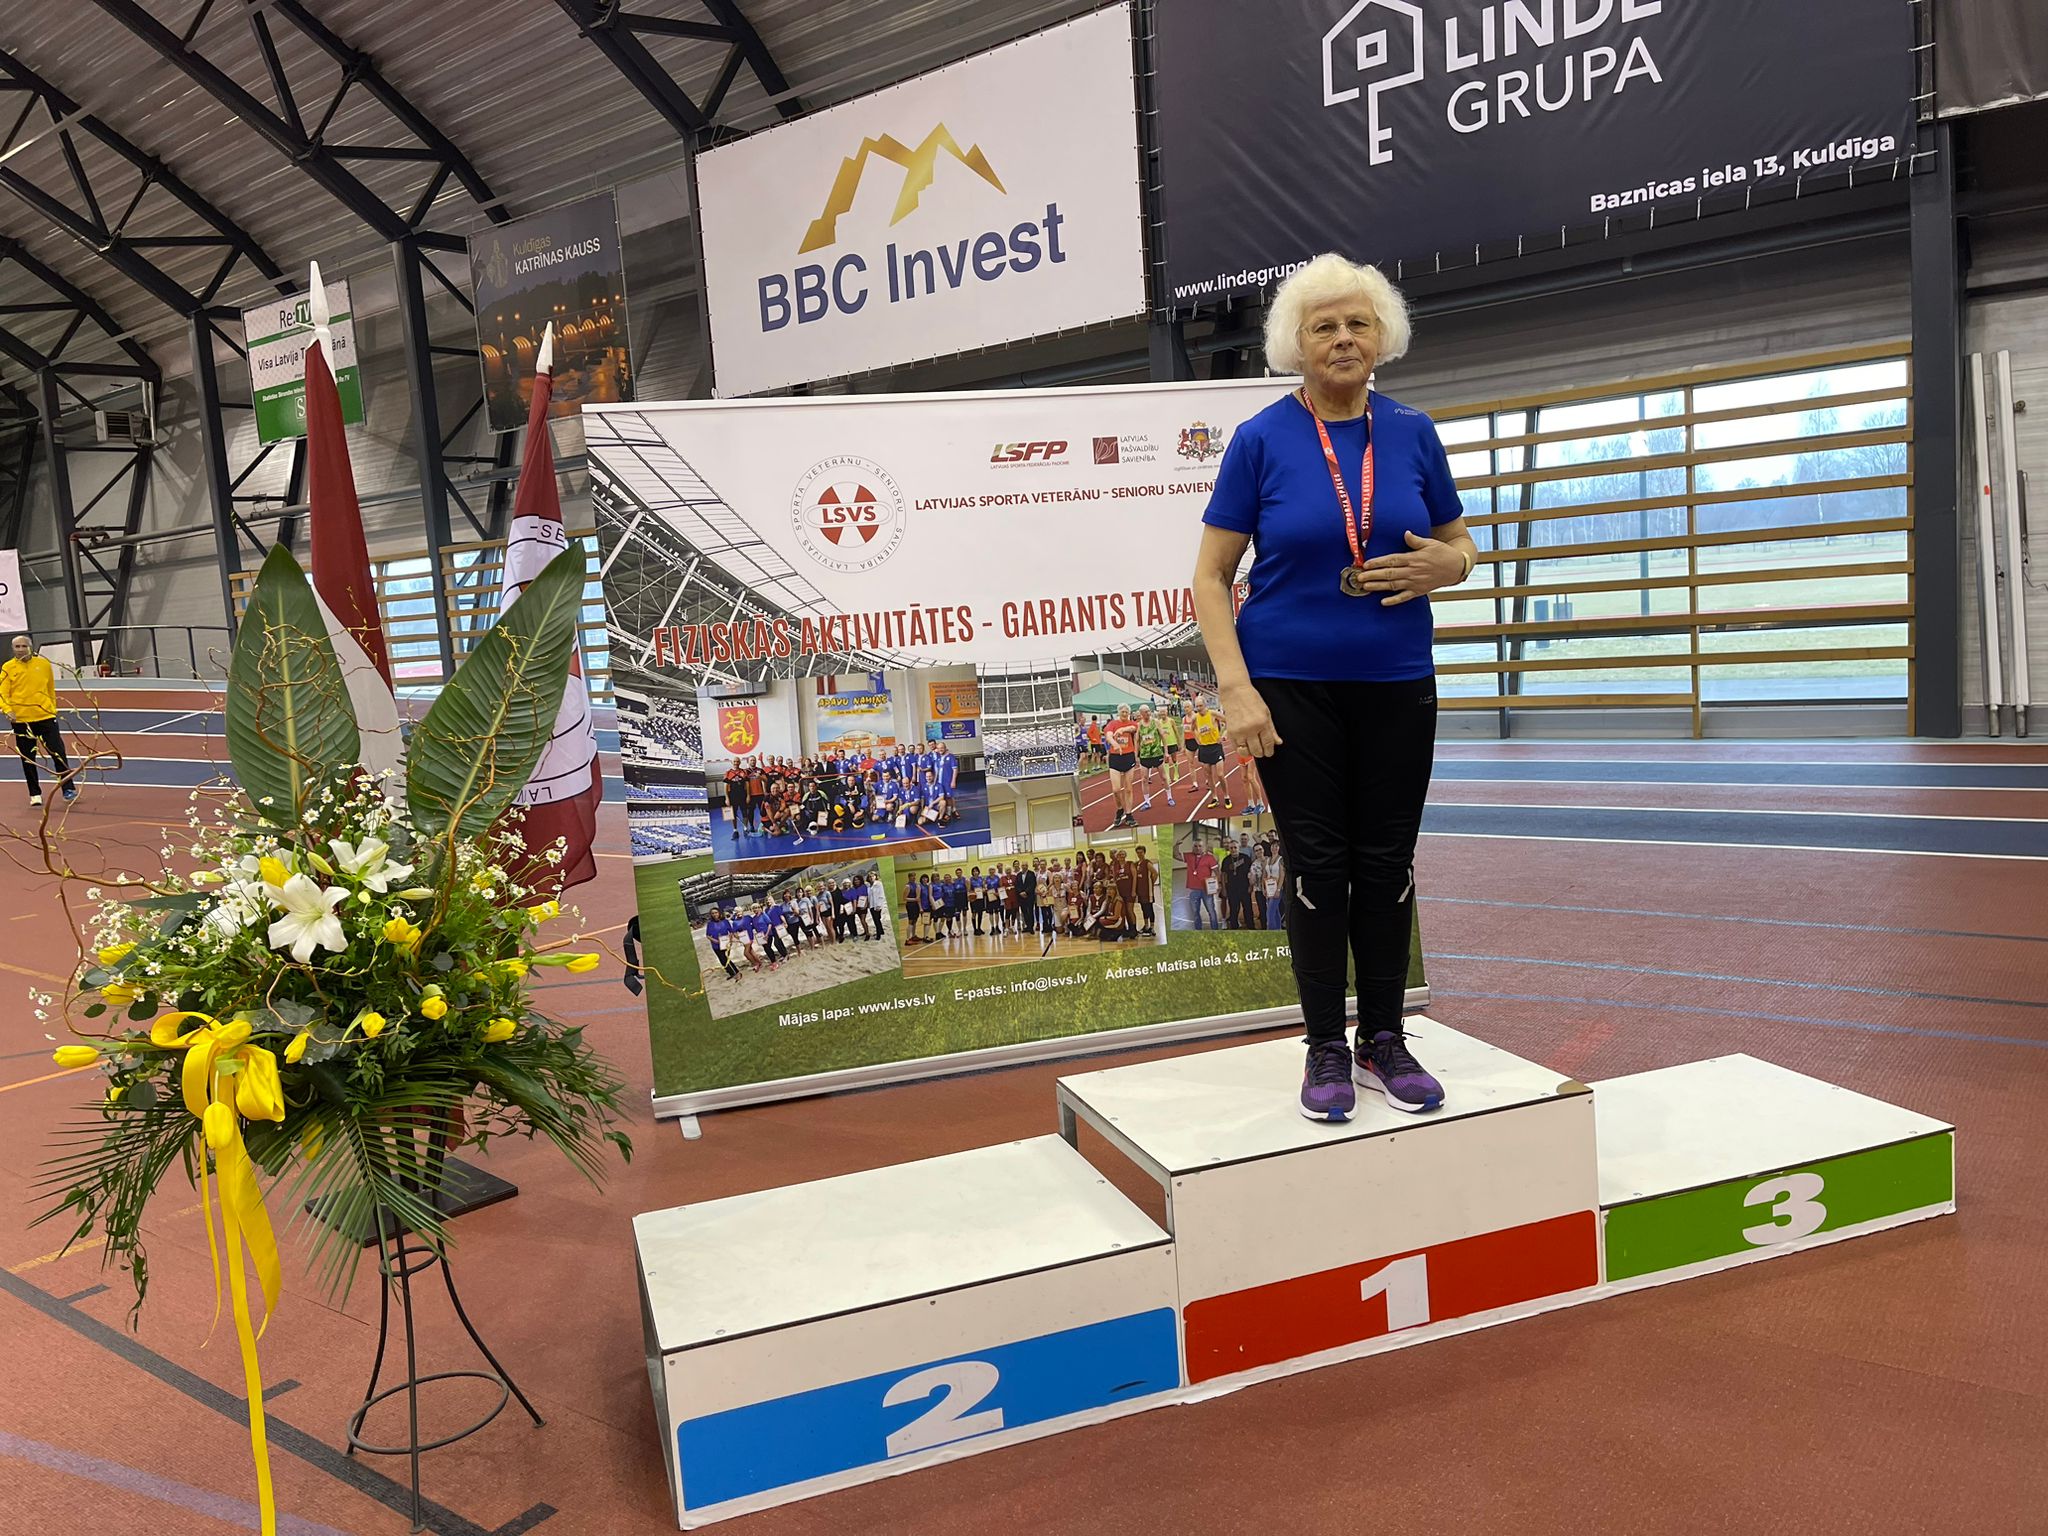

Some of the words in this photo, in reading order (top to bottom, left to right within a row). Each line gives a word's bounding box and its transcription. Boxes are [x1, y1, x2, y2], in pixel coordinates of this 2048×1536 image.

[1447, 36, 1663, 133] GRUPA
[1590, 174, 1697, 214] Baznīcas
[1702, 163, 1748, 190] iela
[1753, 155, 1786, 179] 13,
[1792, 134, 1896, 171] Kuldīga
[512, 236, 552, 257] Kuldīgas
[514, 249, 565, 276] KATRĪNAS
[564, 237, 601, 261] KAUSS
[757, 252, 869, 333] BBC
[886, 201, 1067, 304] Invest
[1174, 255, 1317, 299] www.lindegrupa
[258, 357, 274, 371] Visa
[275, 350, 299, 367] Latvija
[990, 440, 1068, 462] LSFP
[1120, 434, 1149, 443] LATVIJAS
[915, 496, 976, 511] LATVIJAS
[979, 493, 1030, 507] SPORTA
[1031, 488, 1101, 504] VETERĀNU
[1111, 485, 1165, 499] SENIORU
[1168, 479, 1216, 495] SAVIEN
[822, 505, 877, 524] LSVS
[652, 613, 793, 669] FIZISKĀS
[801, 603, 975, 657] AKTIVITĀTES
[1002, 592, 1126, 640] GARANTS
[1131, 587, 1199, 628] TAVA
[1105, 964, 1153, 980] Adrese:
[1156, 958, 1197, 974] Matīsa
[1200, 955, 1222, 968] iela
[1224, 952, 1243, 965] 43,
[1245, 947, 1273, 962] dz.7,
[954, 984, 1007, 1001] E-pasts:
[1010, 972, 1088, 992] info@lsvs.lv
[778, 1011, 819, 1027] Mājas
[822, 1007, 855, 1022] lapa:
[858, 993, 936, 1015] www.lsvs.lv
[1742, 1173, 1827, 1245] 3
[1360, 1253, 1431, 1332] 1
[883, 1361, 1004, 1457] 2
